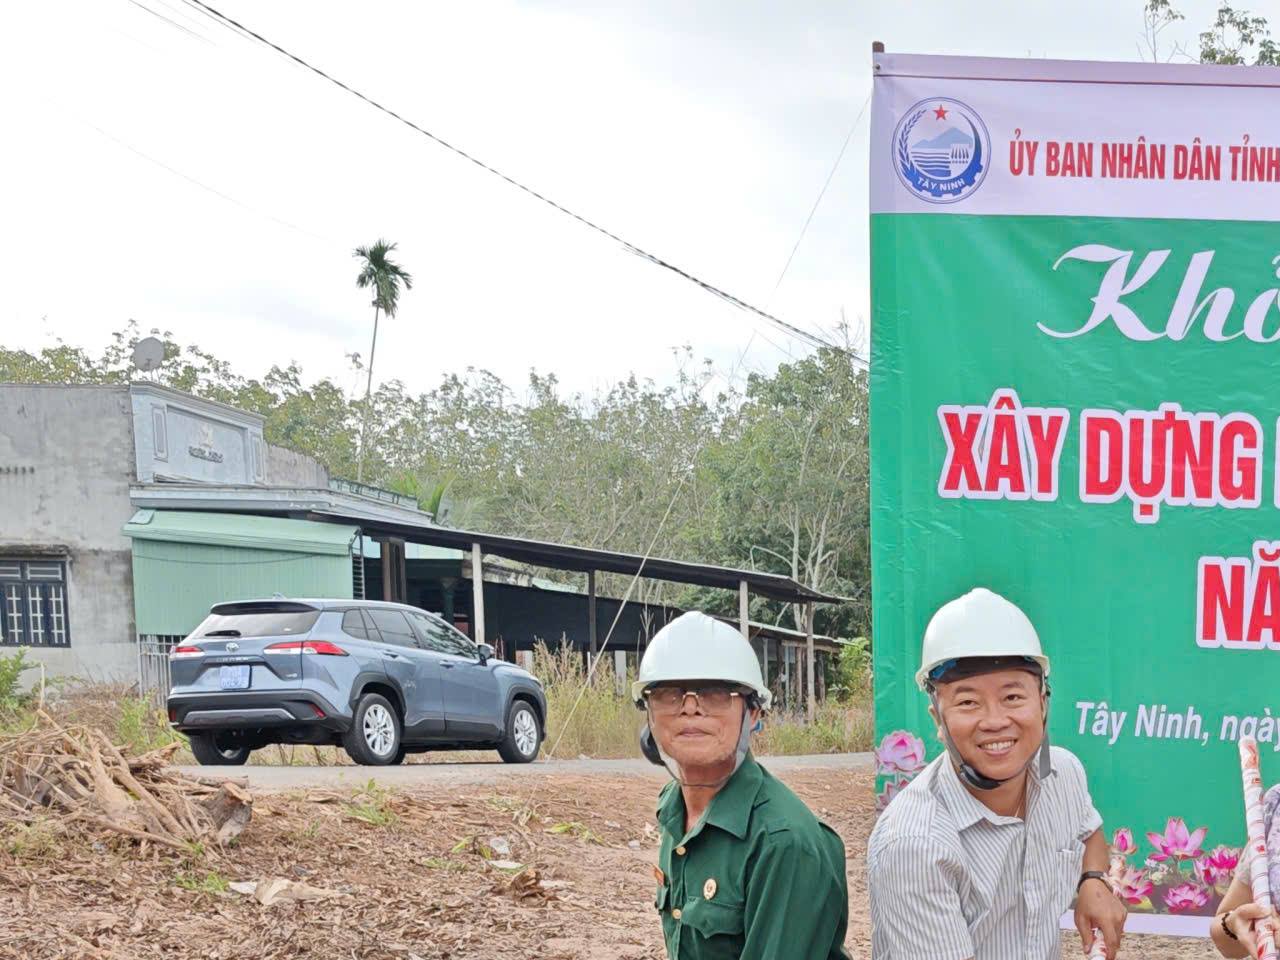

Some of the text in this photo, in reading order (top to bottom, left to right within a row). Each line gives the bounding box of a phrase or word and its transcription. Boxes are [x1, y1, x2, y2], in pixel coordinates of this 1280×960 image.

[1009, 127, 1039, 177] ỦY
[1045, 141, 1094, 178] BAN
[1101, 135, 1166, 180] NHÂN
[1173, 136, 1222, 182] DÂN
[940, 177, 966, 191] NINH
[940, 392, 1067, 497] XÂY
[1082, 406, 1260, 519] DỰNG
[1075, 701, 1127, 745] Tây
[1134, 703, 1209, 746] Ninh,
